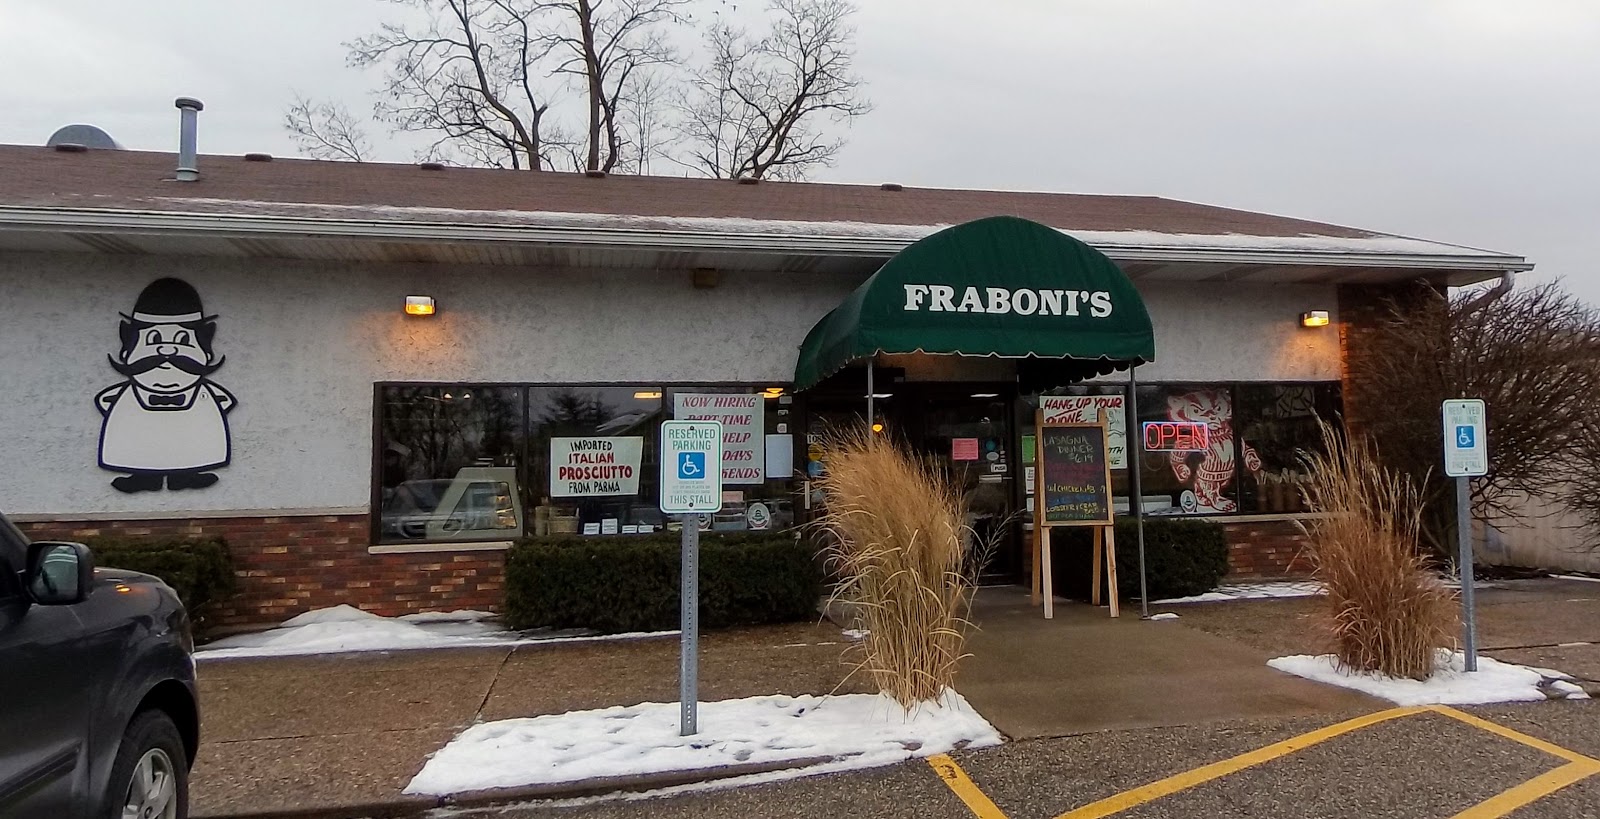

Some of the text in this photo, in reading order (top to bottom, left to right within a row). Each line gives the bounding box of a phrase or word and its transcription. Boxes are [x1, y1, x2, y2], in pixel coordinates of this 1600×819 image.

[903, 284, 1113, 318] FRABONI'S
[682, 396, 757, 408] NOW HIRING
[1044, 397, 1123, 410] HANG UP YOUR
[721, 414, 753, 426] TIME
[668, 428, 716, 439] RESERVED
[1145, 423, 1208, 449] OPEN
[570, 439, 613, 452] IMPORTED
[672, 440, 712, 451] PARKING
[1043, 435, 1089, 447] LASAGNA
[1058, 444, 1094, 454] DINNER
[568, 452, 615, 464] ITALIAN
[558, 465, 633, 480] PROSCIUTTO
[568, 481, 621, 494] FROM PARMA
[669, 495, 714, 504] THIS STALL
